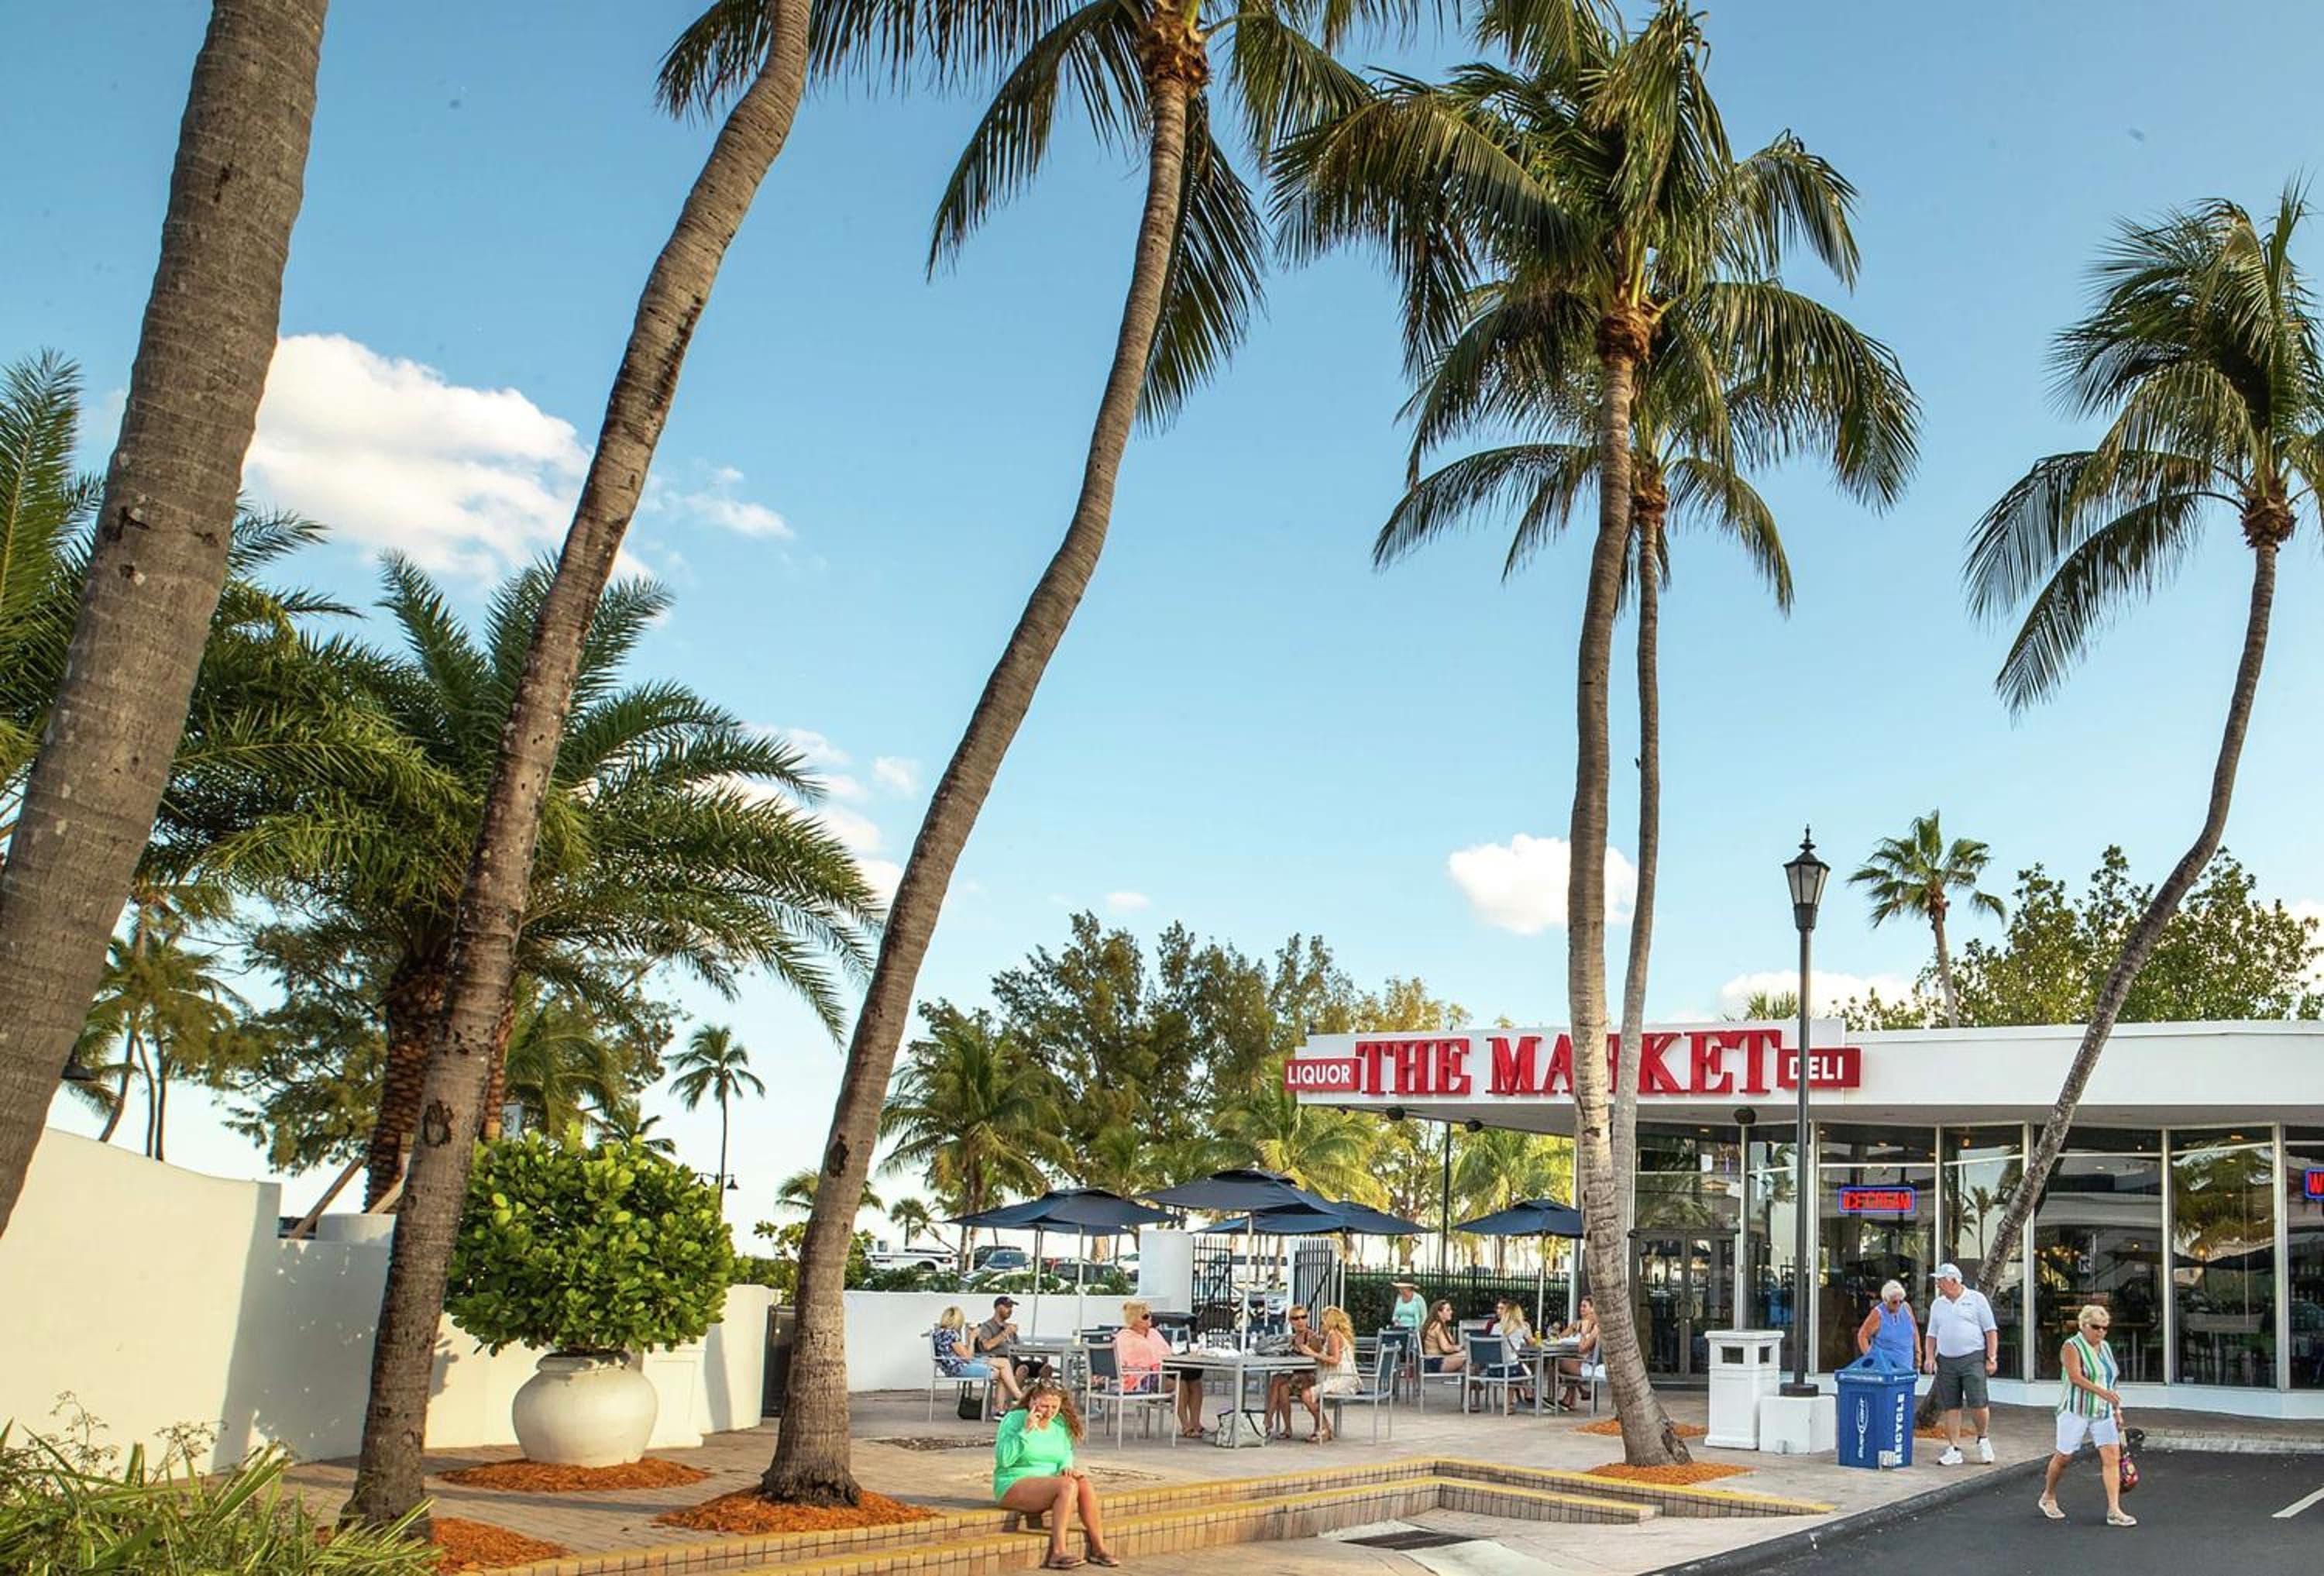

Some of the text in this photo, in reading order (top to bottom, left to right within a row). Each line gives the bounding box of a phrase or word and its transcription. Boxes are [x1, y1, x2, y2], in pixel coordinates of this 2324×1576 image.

[1287, 1064, 1351, 1085] LIQUOR
[1356, 1038, 1471, 1094] THE
[1788, 1055, 1844, 1080] DELI
[1895, 1392, 1905, 1464] RECYCLE
